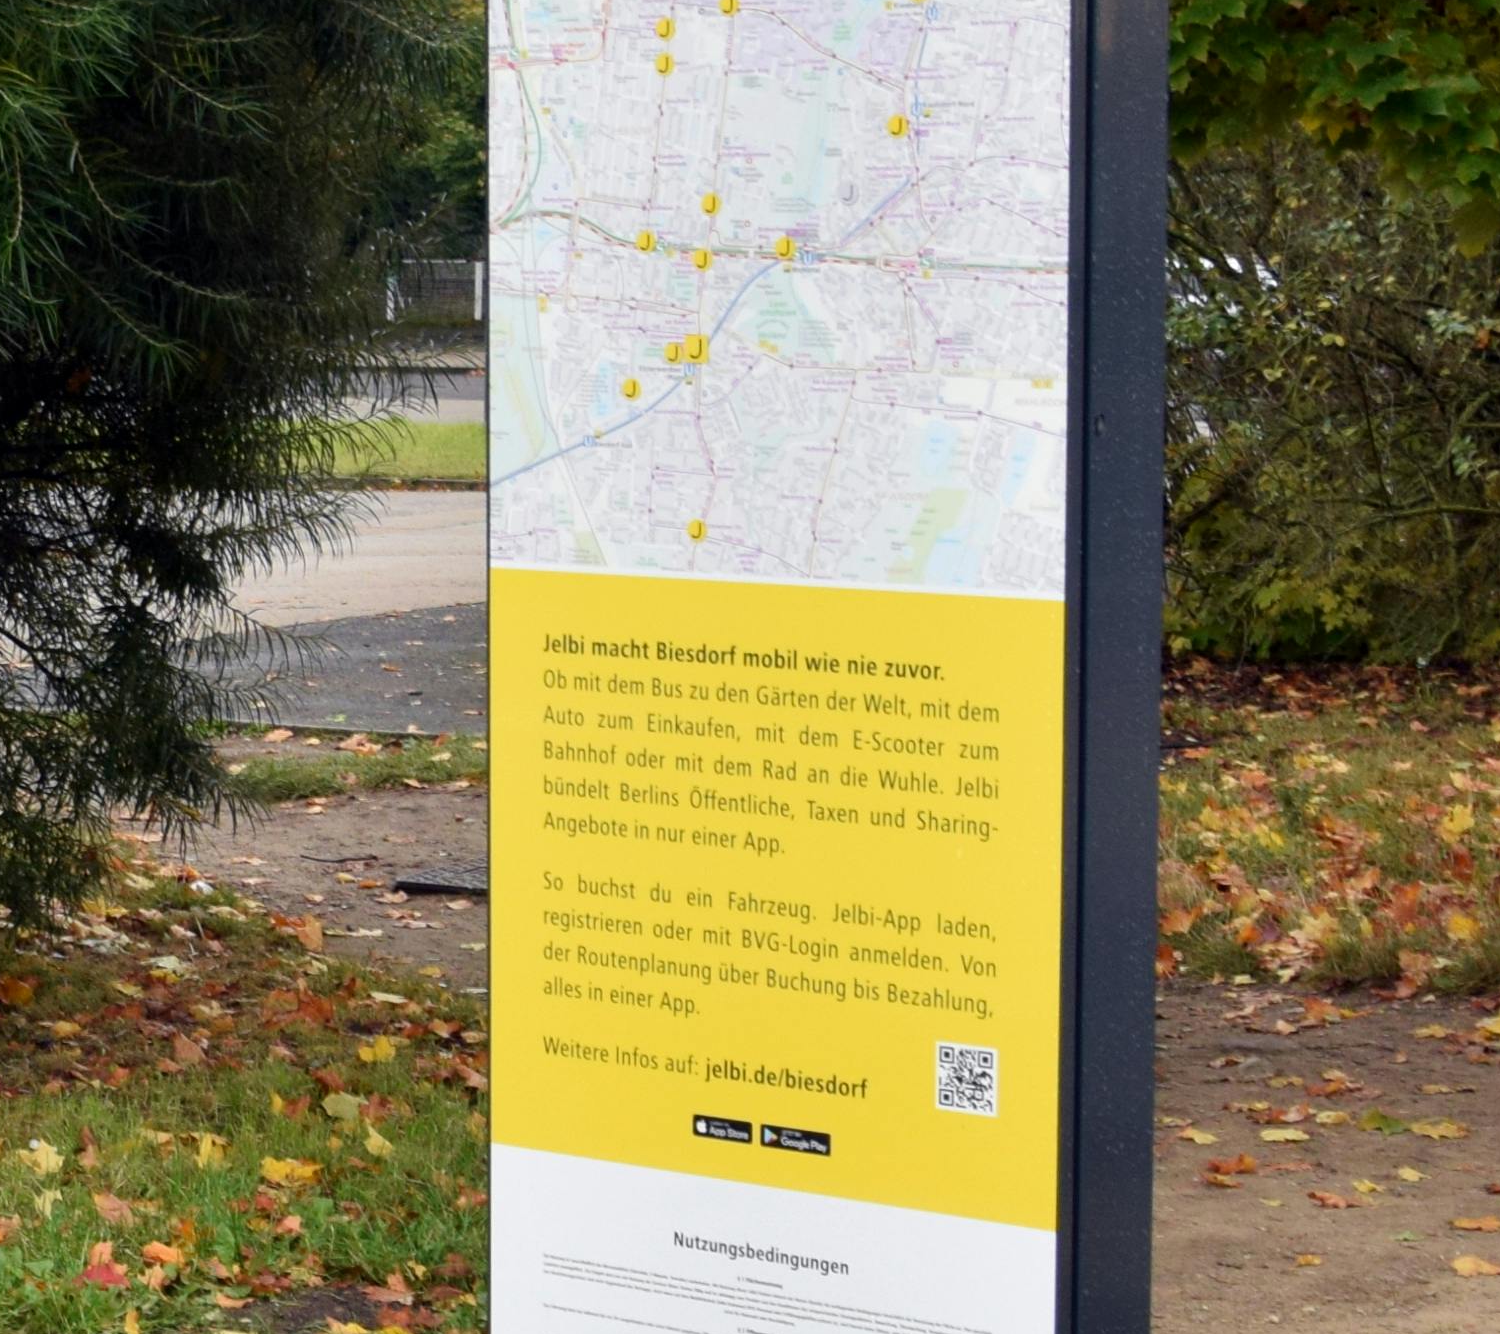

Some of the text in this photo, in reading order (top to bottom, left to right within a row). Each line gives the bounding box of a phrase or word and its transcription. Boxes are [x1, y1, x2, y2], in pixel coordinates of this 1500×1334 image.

[542, 632, 945, 681] Jelbi macht Biesdorf mobil wie nie zuvor.
[542, 668, 1000, 723] Ob mit dem Bus zu den Gärten der Welt, mit dem
[542, 704, 999, 761] Auto zum Einkaufen, mit dem E-Scooter zum
[542, 739, 999, 799] Bahnhof oder mit dem Rad an die Wuhle. Jelbi
[542, 774, 998, 843] bündelt Berlins Öffentliche, Taxen und Sharing-
[542, 810, 785, 858] Angebote in nur einer App.
[542, 869, 996, 943] So buchst du ein Fahrzeug. Jelbi-App laden,
[542, 908, 996, 978] registrieren oder mit BVG-Login anmelden. Von
[542, 939, 993, 1020] der Routenplanung über Buchung bis Bezahlung,
[542, 975, 700, 1019] alles in einer App.
[542, 1034, 868, 1099] Weitere Infos auf: jelbi.de/biesdorf
[709, 1126, 726, 1137] App
[780, 1137, 828, 1153] Google Play
[674, 1231, 849, 1276] Nutzungsbedingungen
